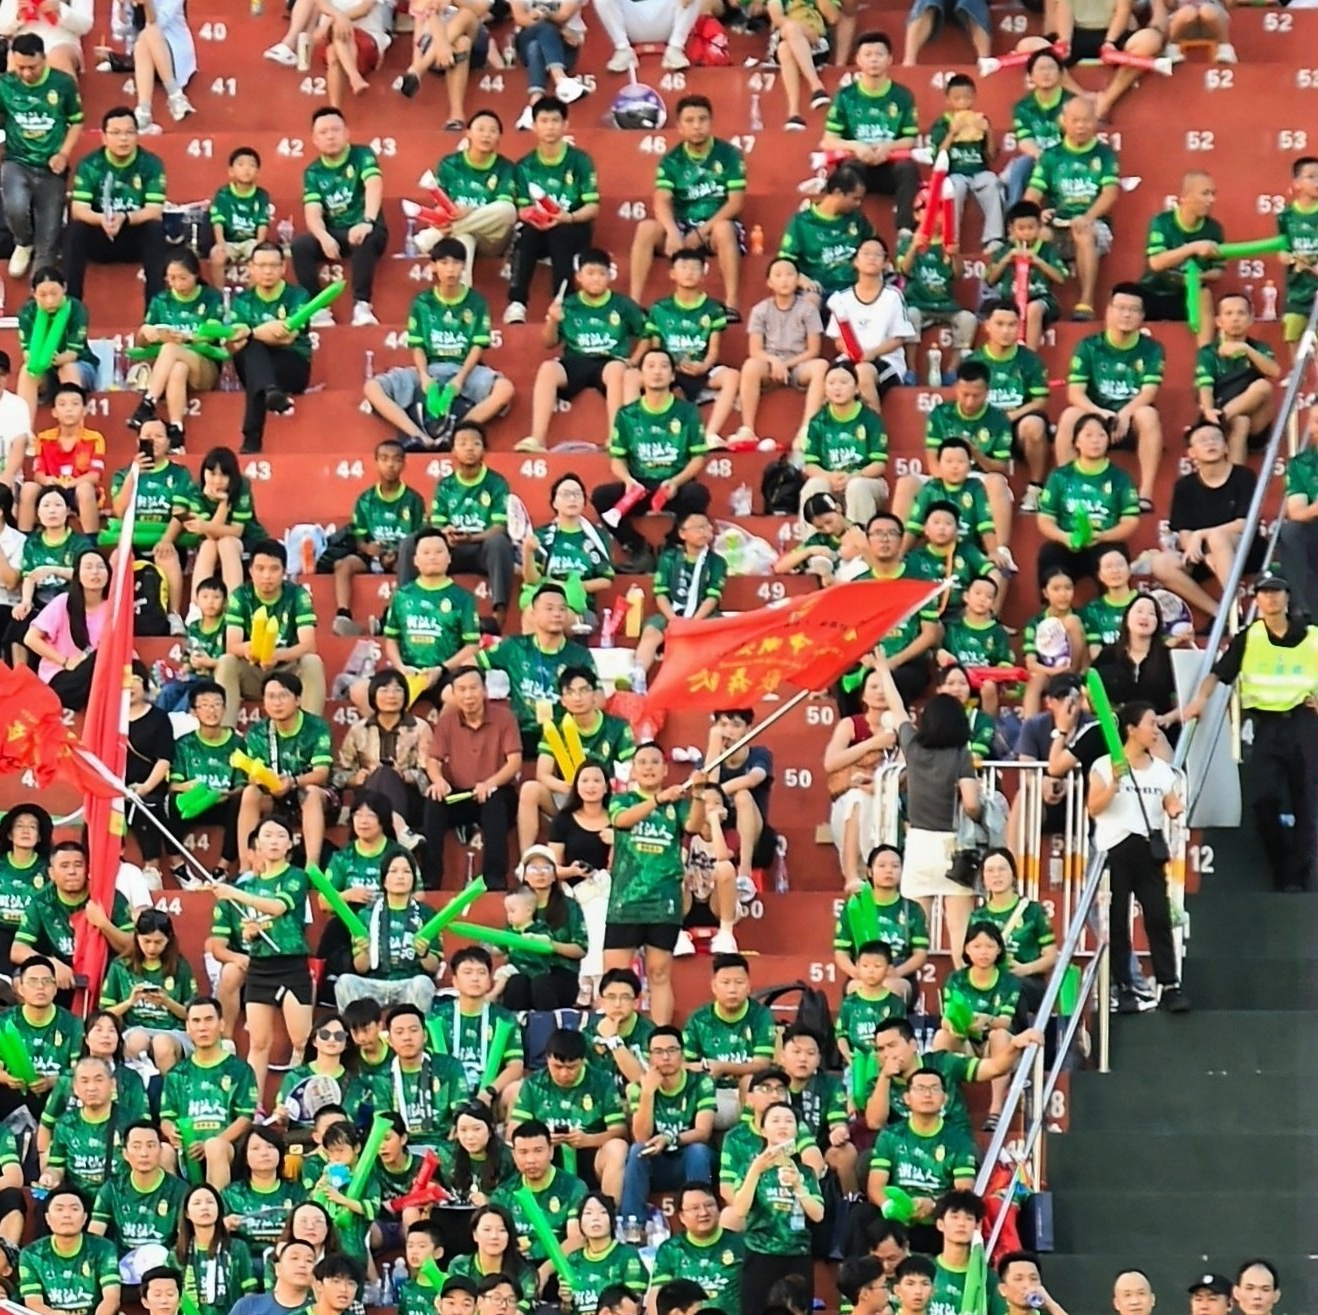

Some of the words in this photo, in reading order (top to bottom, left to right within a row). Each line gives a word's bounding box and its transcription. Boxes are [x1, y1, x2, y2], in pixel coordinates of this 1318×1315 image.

[1263, 12, 1293, 32] 52
[210, 77, 237, 97] 41
[186, 138, 213, 159] 41
[368, 137, 397, 158] 43
[638, 134, 667, 156] 46
[1186, 130, 1215, 151] 52
[334, 459, 365, 480] 44
[519, 458, 548, 480] 46
[705, 458, 732, 478] 48
[154, 896, 183, 916] 44
[809, 962, 836, 983] 51
